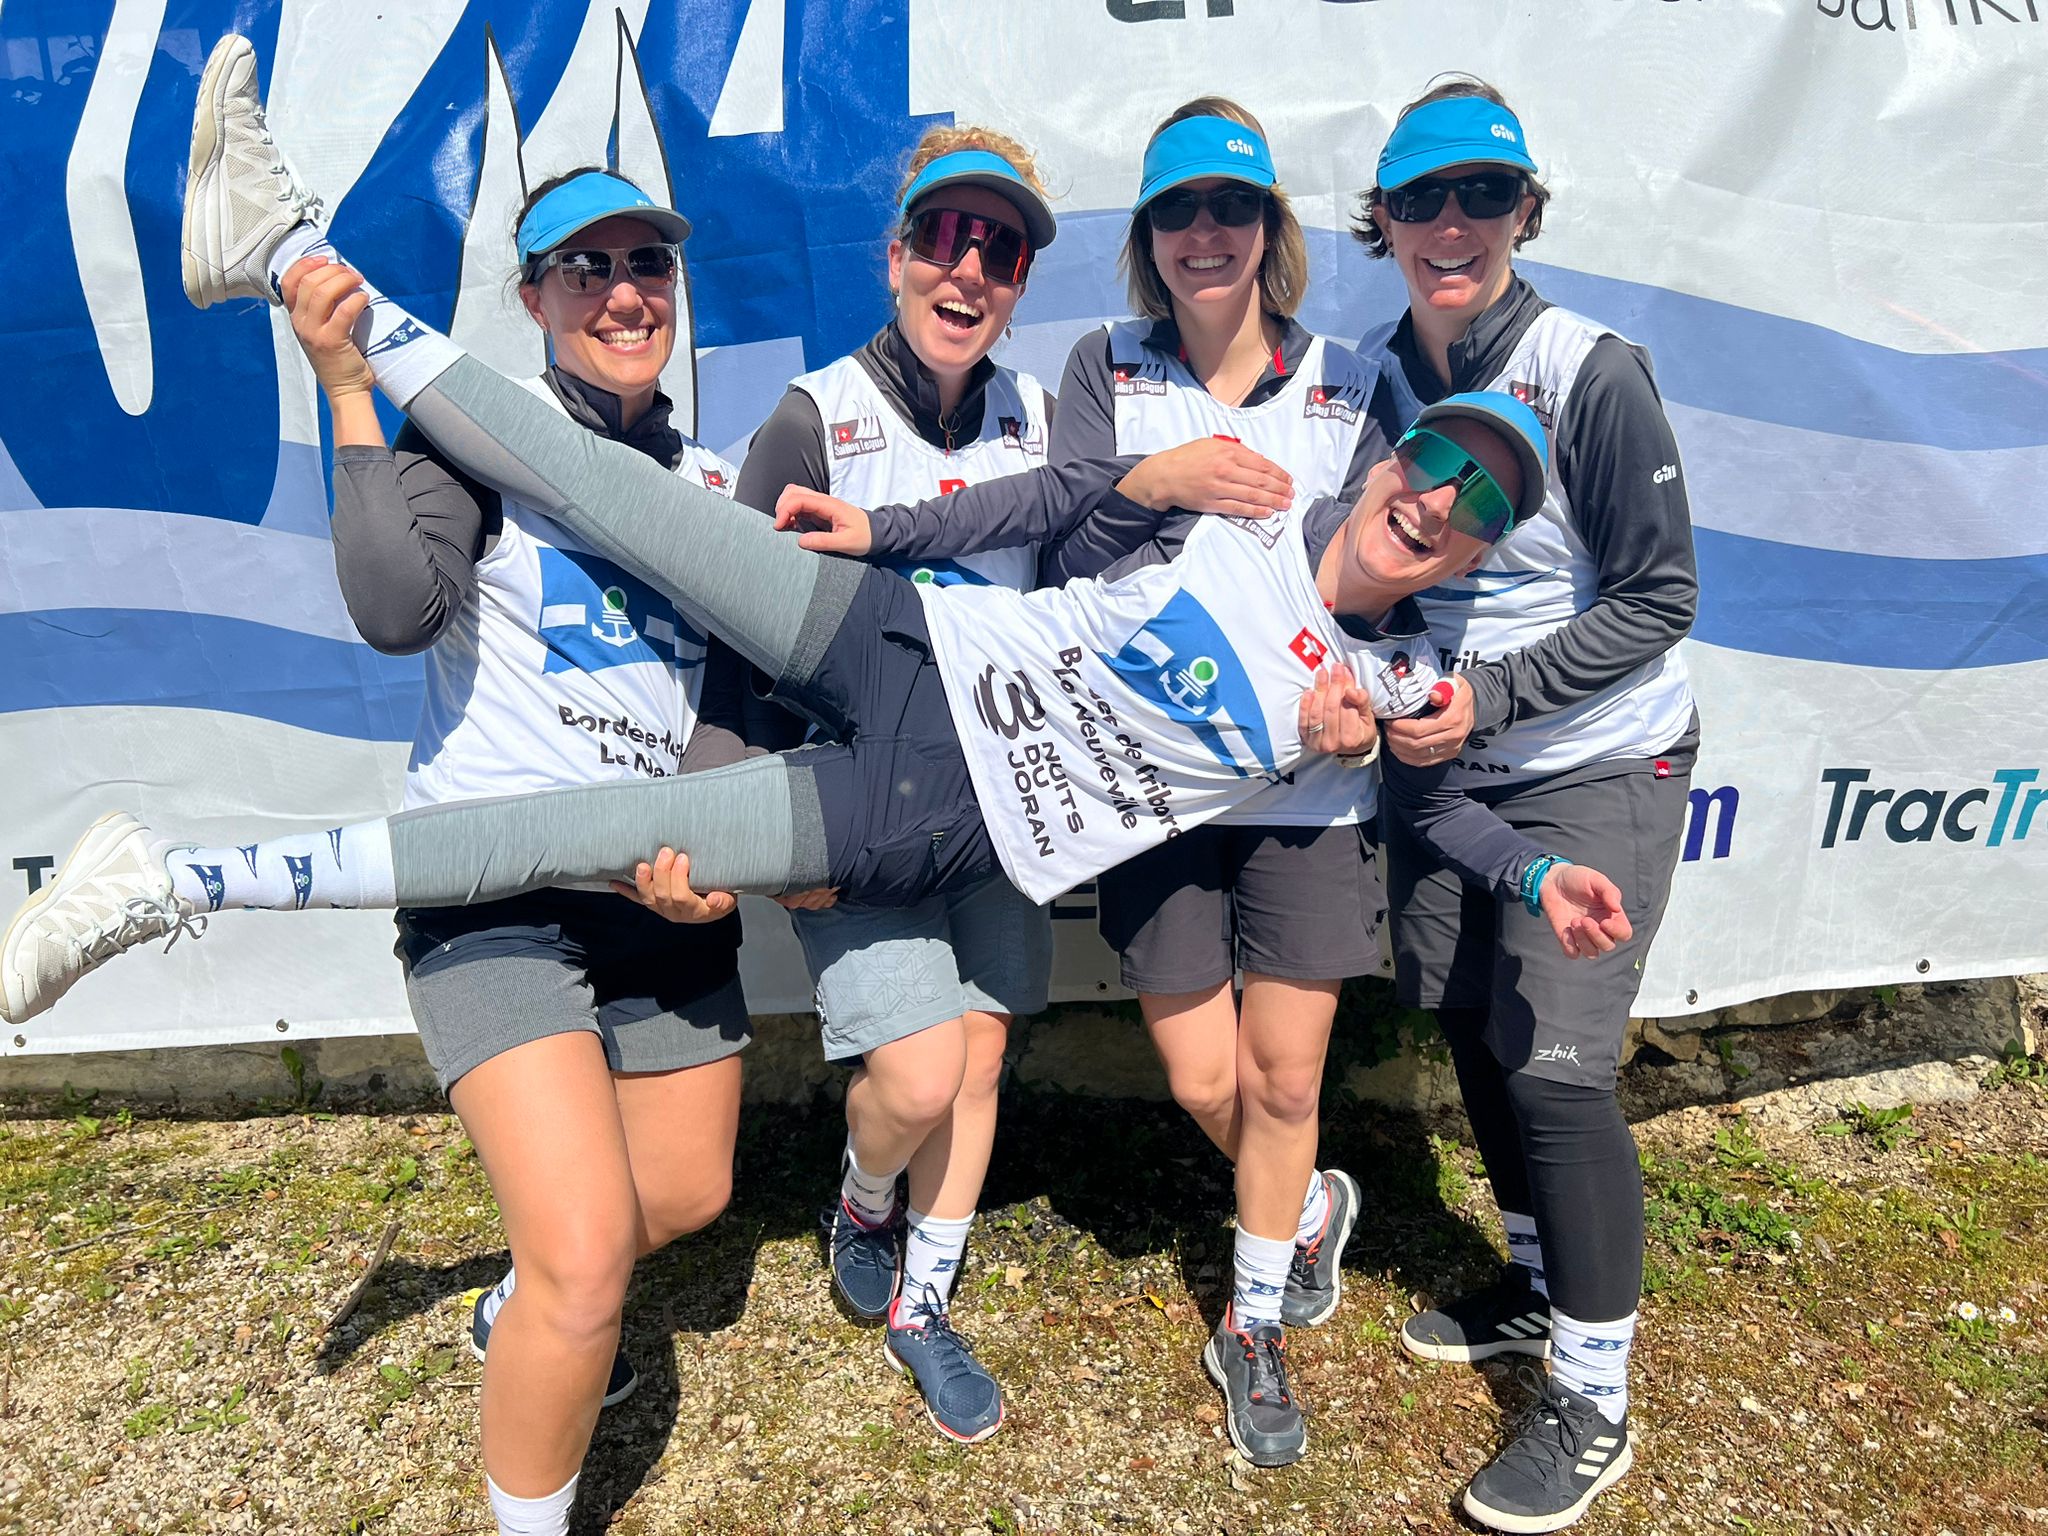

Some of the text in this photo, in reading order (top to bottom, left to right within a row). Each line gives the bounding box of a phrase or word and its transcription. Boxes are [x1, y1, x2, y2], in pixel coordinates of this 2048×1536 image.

[1226, 138, 1254, 157] Gill
[1490, 124, 1516, 143] Gill
[1136, 381, 1165, 394] League
[1653, 464, 1677, 484] Gill
[1023, 744, 1050, 788] DU
[1007, 750, 1055, 858] JORAN
[1041, 742, 1085, 834] NUITS
[1821, 768, 2048, 849] TracTr
